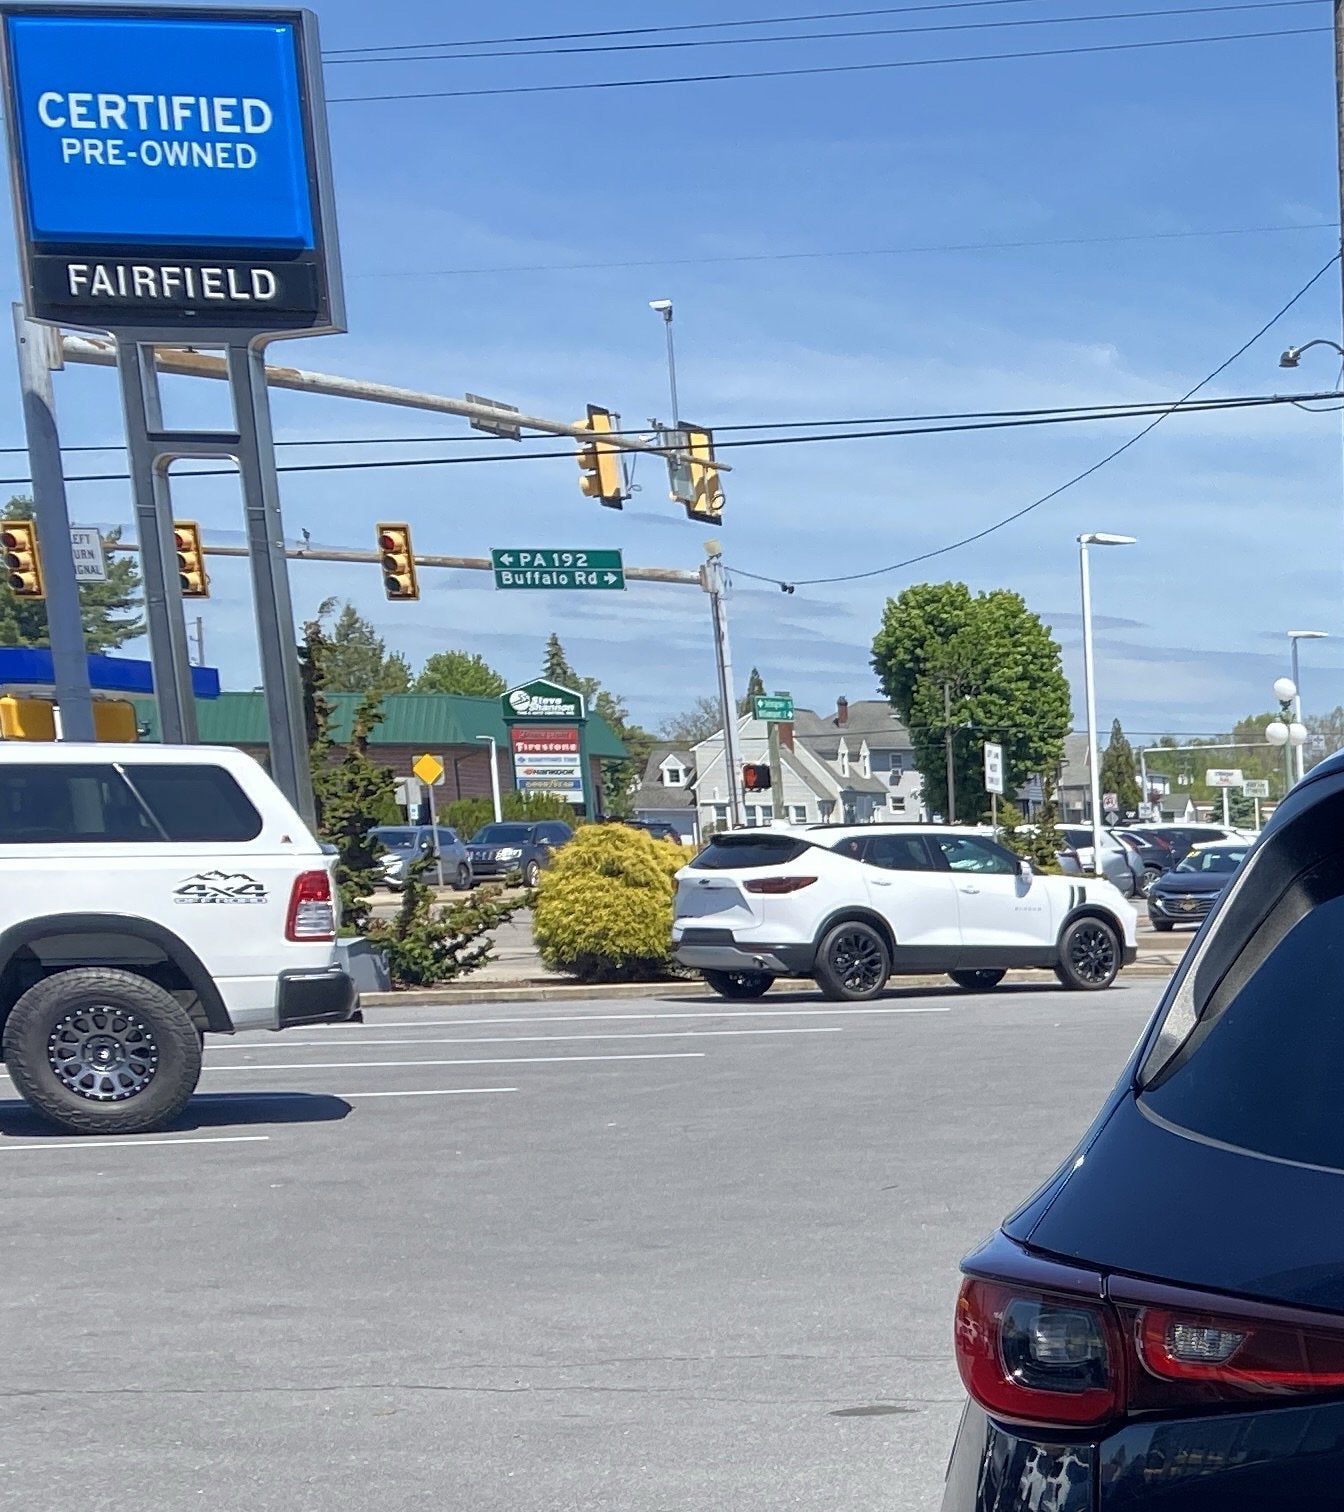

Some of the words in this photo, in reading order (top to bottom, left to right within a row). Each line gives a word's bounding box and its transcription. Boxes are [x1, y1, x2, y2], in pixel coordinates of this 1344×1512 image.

[38, 92, 273, 134] CERTIFIED
[61, 138, 257, 169] PRE-OWNED
[68, 264, 276, 300] FAIRFIELD
[71, 534, 91, 545] EFT
[73, 549, 95, 560] URN
[520, 553, 546, 567] PA
[552, 553, 588, 567] 192
[75, 565, 103, 575] IGNAL
[501, 571, 568, 585] Buffalo
[574, 571, 598, 585] Rd
[516, 742, 577, 752] Firestone
